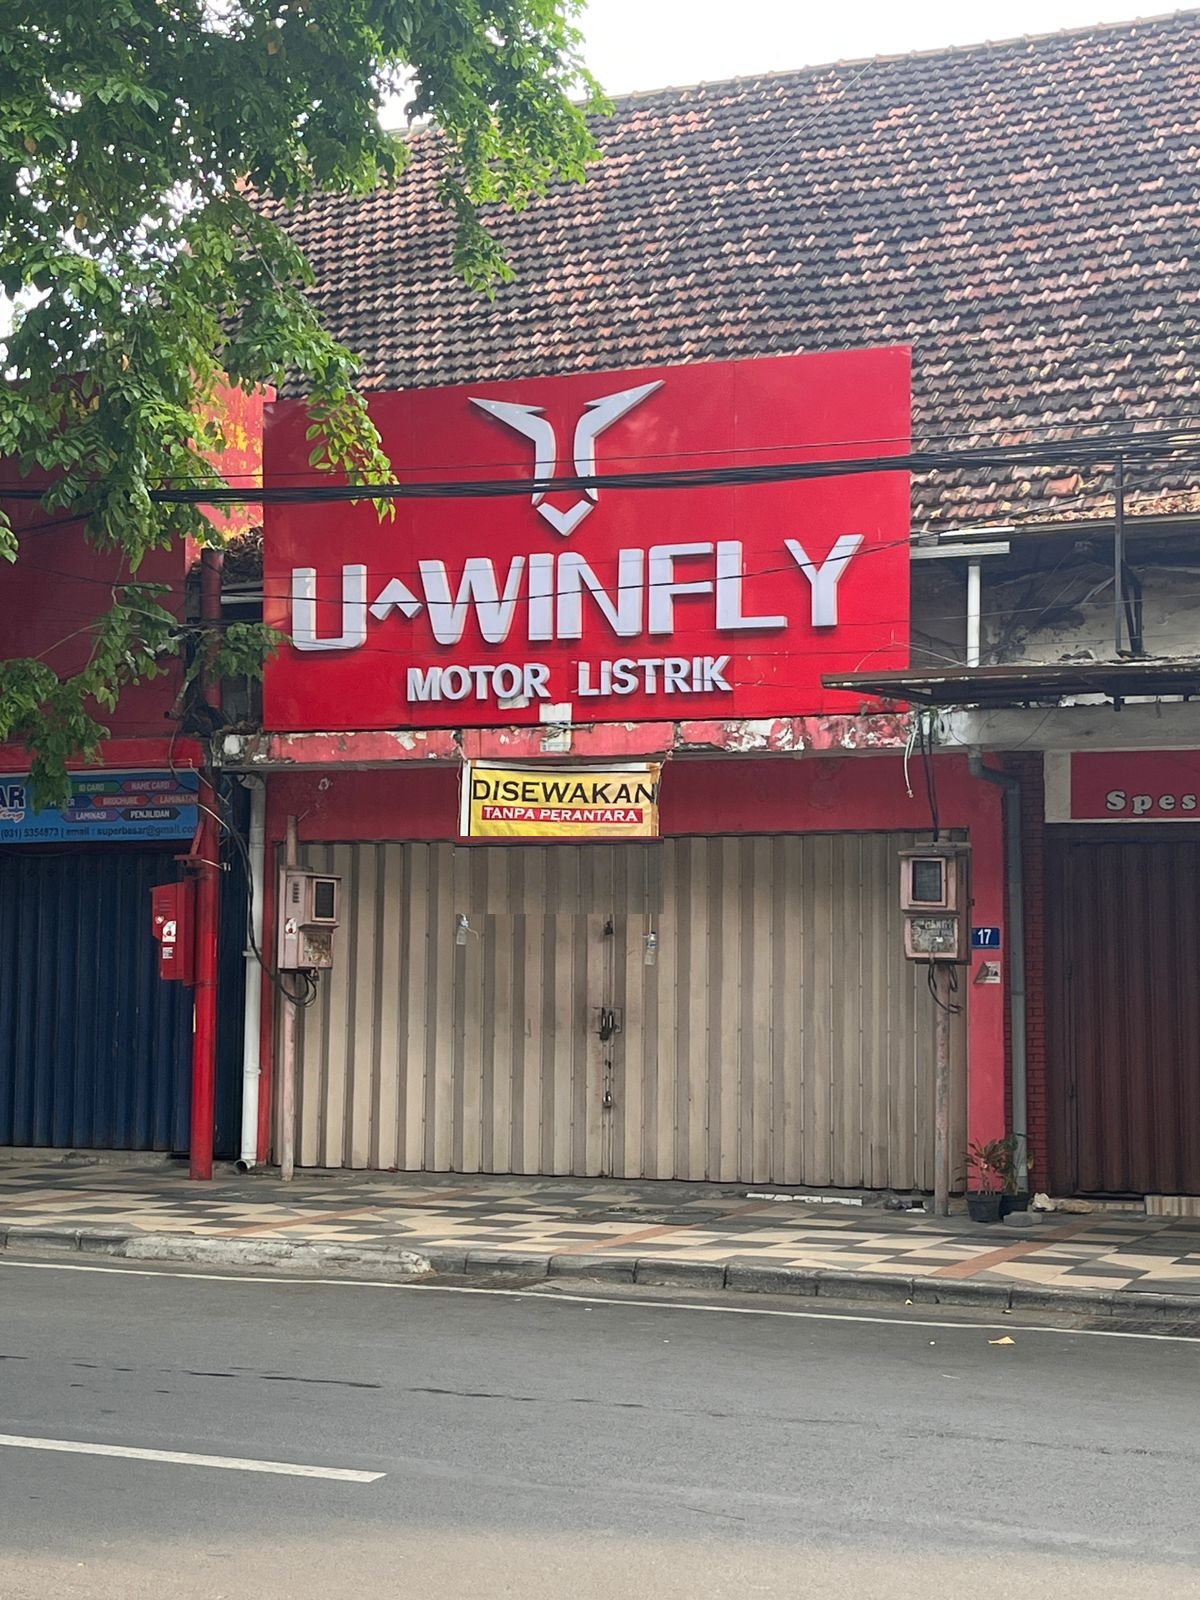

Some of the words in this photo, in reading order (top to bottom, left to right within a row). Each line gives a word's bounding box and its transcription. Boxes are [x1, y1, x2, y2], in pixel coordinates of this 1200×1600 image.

[407, 663, 551, 702] MOTOR
[577, 655, 733, 697] LISTRIK
[473, 779, 655, 804] DISEWAKAN
[484, 807, 534, 820] TANPA
[539, 809, 638, 822] PERANTARA
[977, 928, 992, 944] 17
